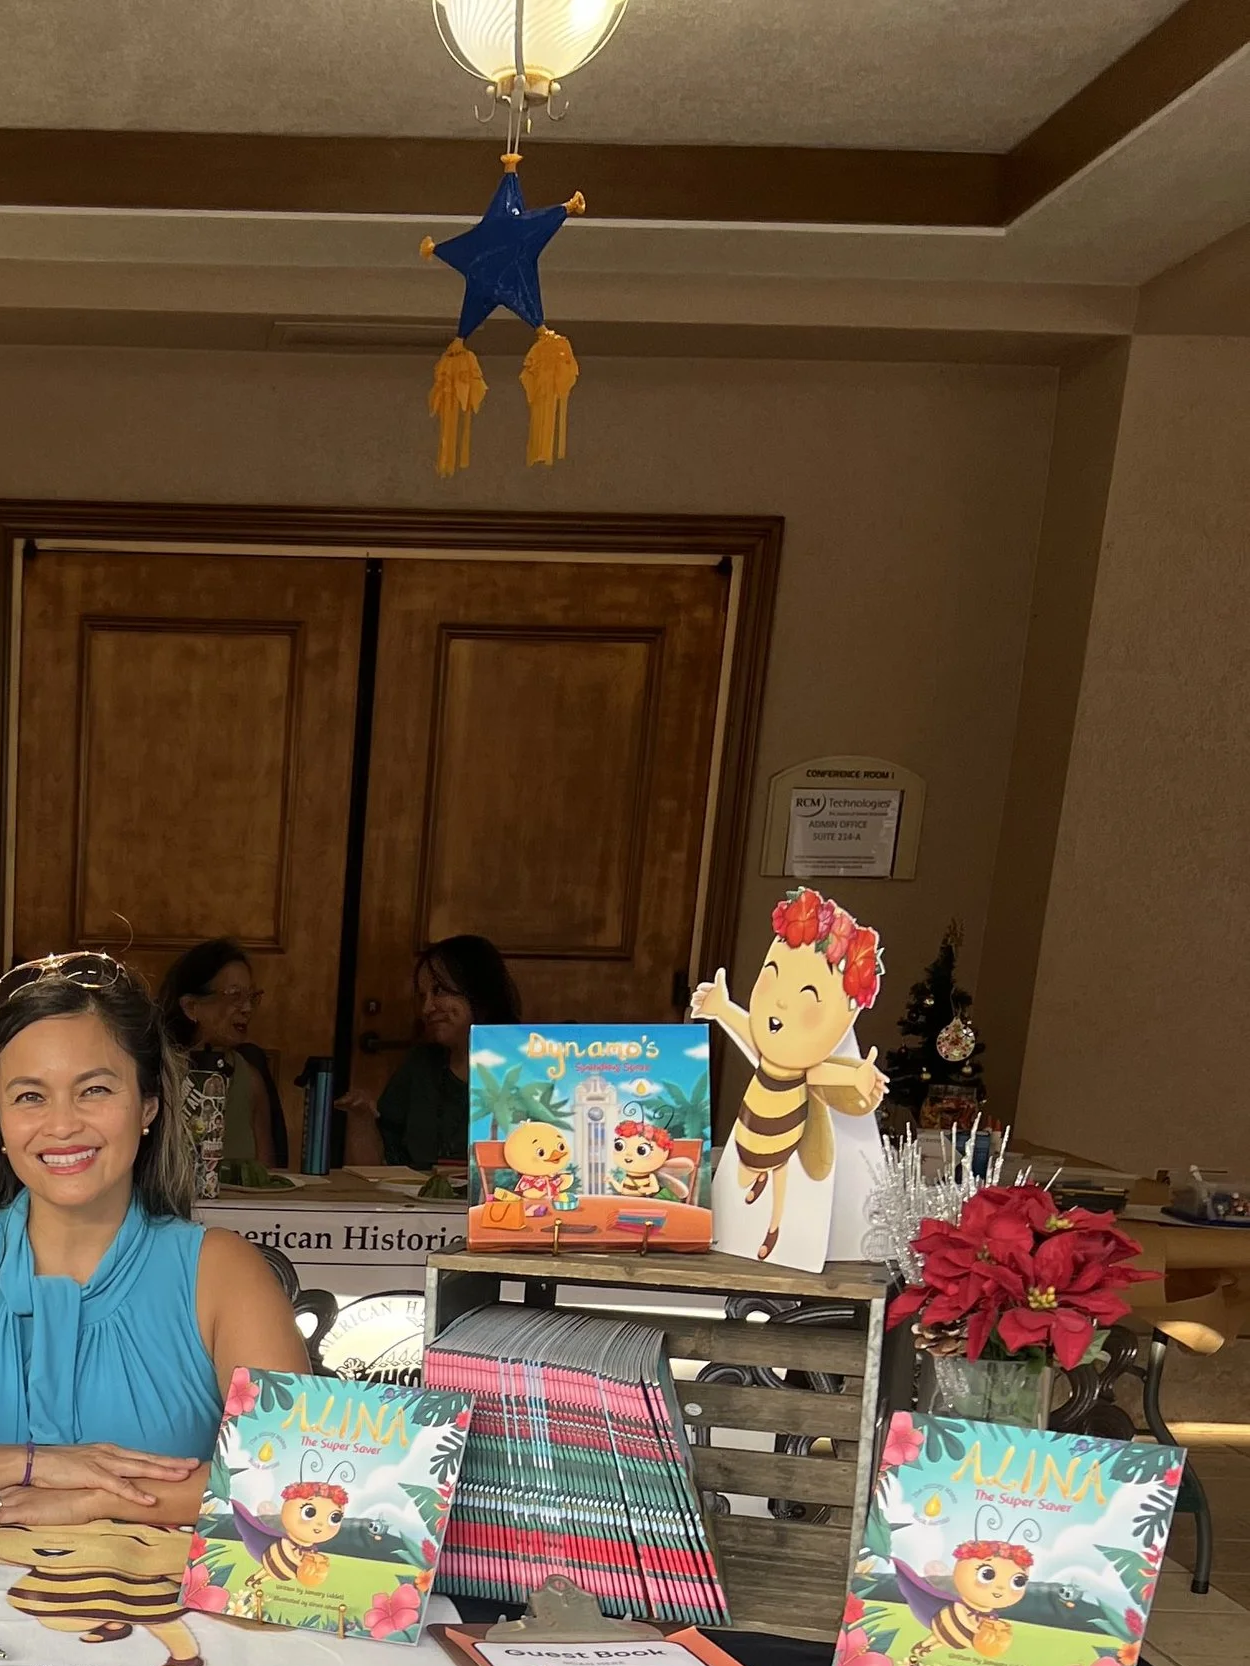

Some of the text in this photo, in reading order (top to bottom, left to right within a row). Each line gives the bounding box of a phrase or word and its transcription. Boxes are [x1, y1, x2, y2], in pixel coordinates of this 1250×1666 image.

[806, 769, 860, 779] CONFERENCE
[863, 770, 889, 779] ROOM
[796, 798, 891, 810] RCM Technologies
[808, 820, 868, 829] ADMIN OFFICE
[813, 833, 835, 841] SUITE
[527, 1032, 659, 1080] Dynamo's
[232, 1224, 333, 1249] erican
[320, 1299, 395, 1352] MERICAN
[281, 1391, 410, 1448] ALINA
[300, 1435, 383, 1455] The Super Saver
[952, 1440, 1107, 1506] ALINA
[974, 1489, 1073, 1513] The Super Saver
[505, 1649, 667, 1659] Guest Book
